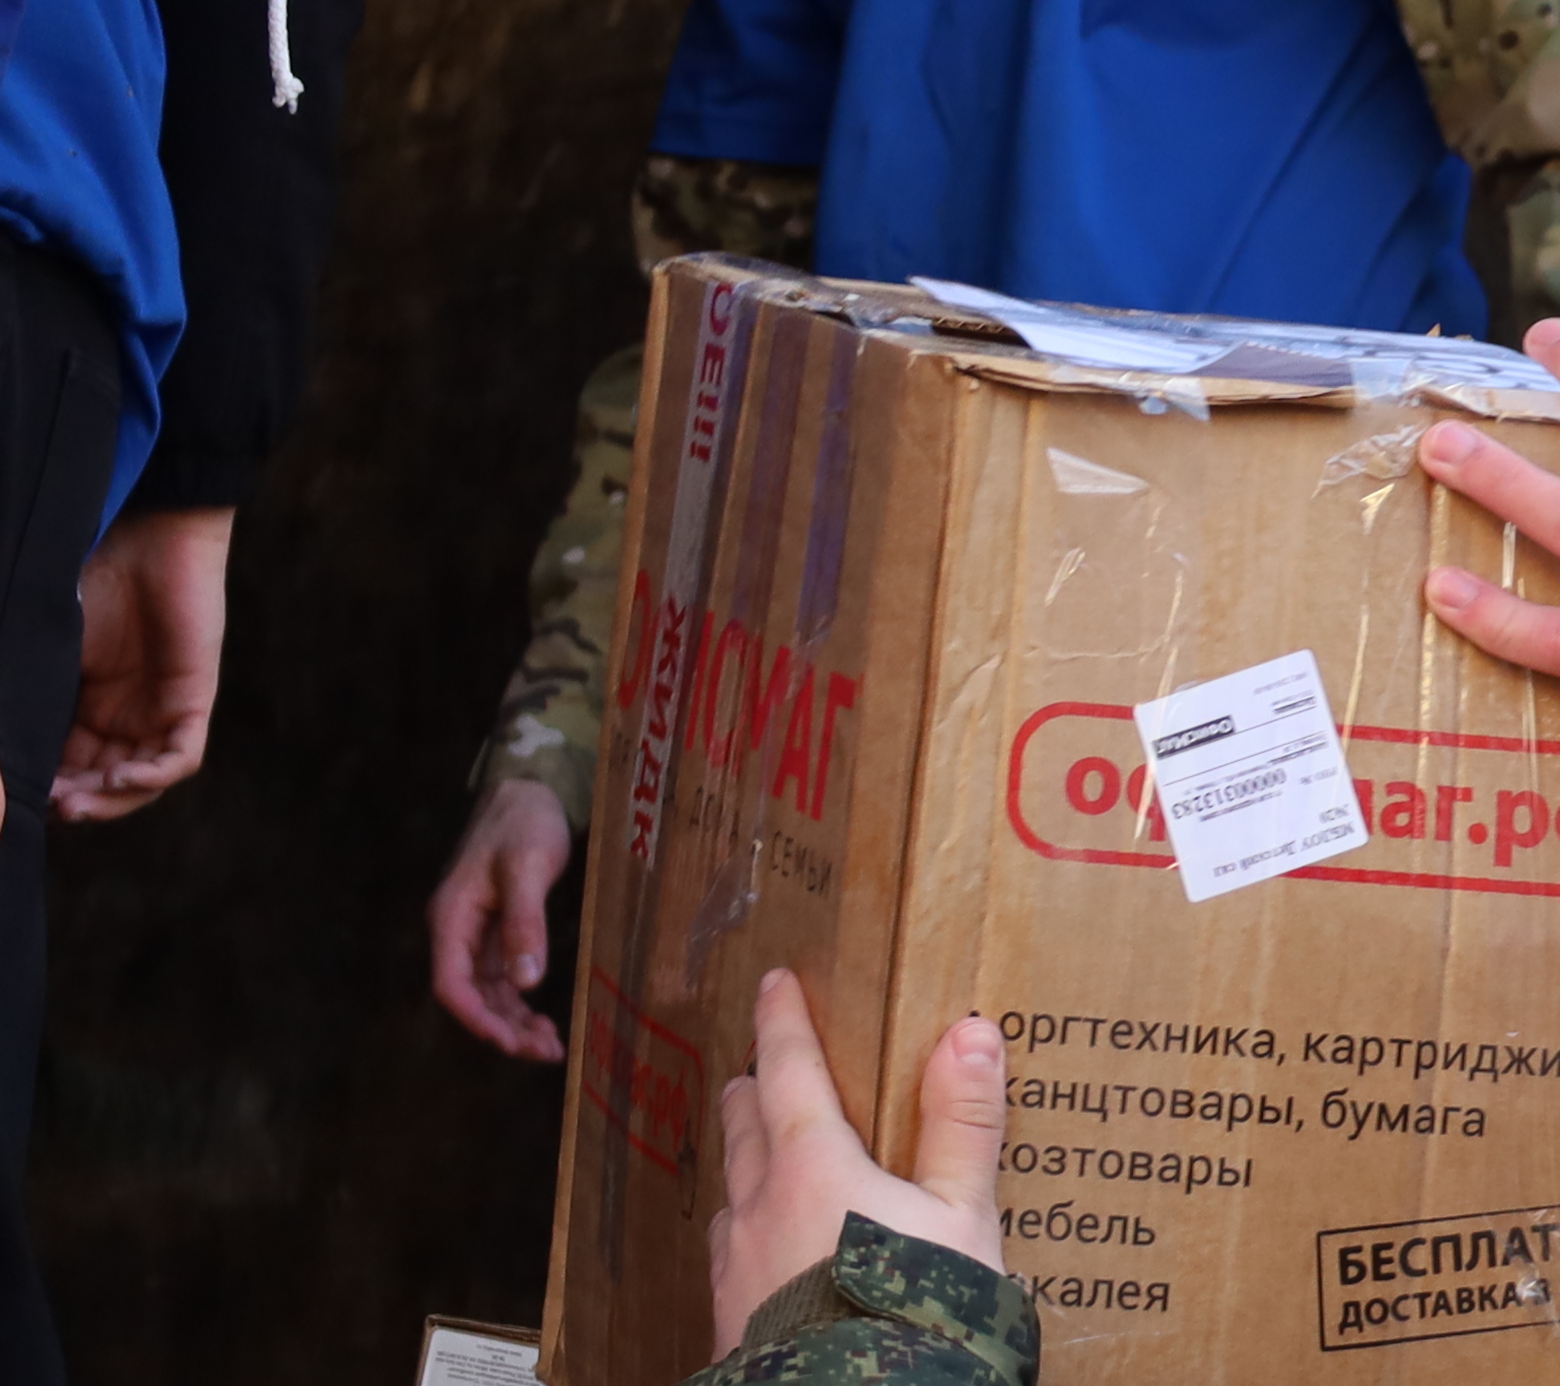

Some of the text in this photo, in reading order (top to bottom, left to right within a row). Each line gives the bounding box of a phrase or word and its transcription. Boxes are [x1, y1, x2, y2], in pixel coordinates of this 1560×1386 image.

[999, 1012, 1286, 1065] оргтехника,
[1320, 1086, 1487, 1139] бумага
[1006, 1272, 1172, 1314] калея
[1338, 1279, 1521, 1335] ДОСТАВКА
